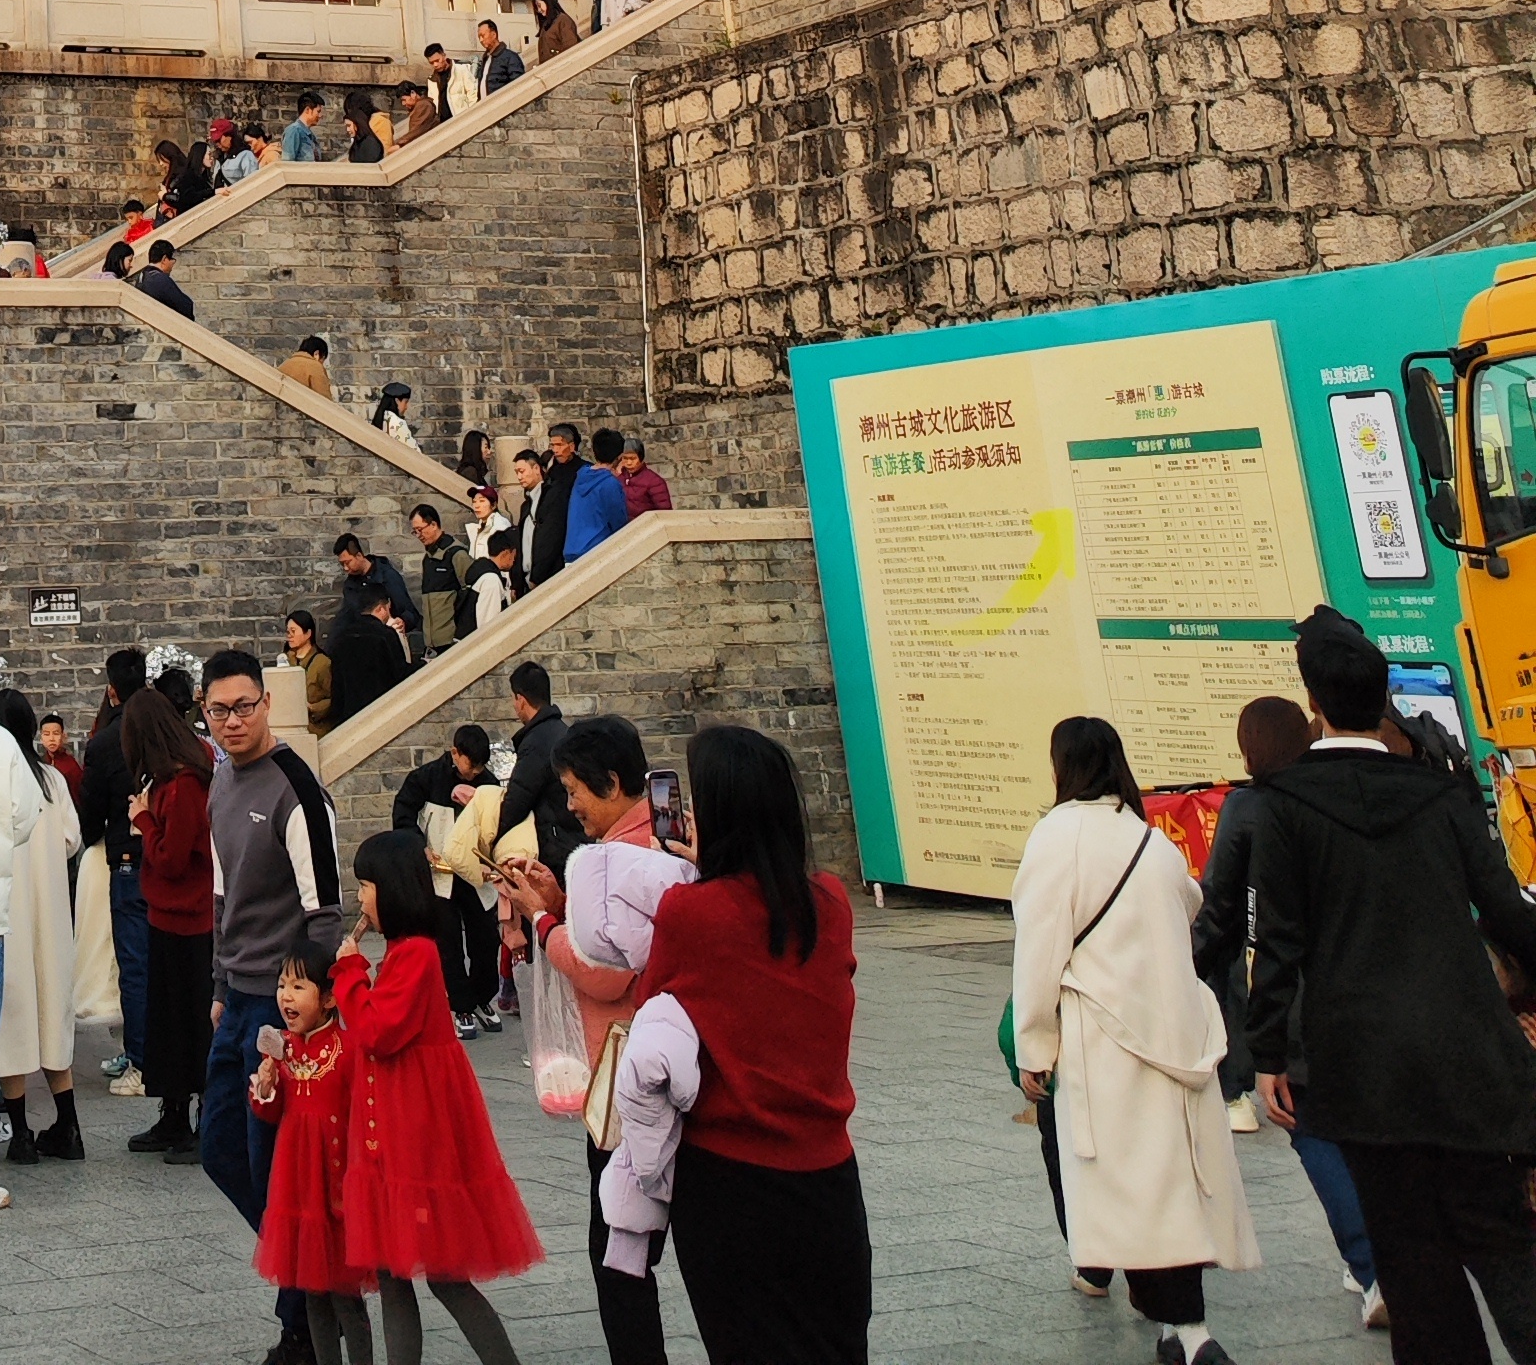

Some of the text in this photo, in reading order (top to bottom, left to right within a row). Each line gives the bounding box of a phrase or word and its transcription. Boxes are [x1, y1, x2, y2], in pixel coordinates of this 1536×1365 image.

[858, 399, 1016, 443] 潮州古城文化旅游区
